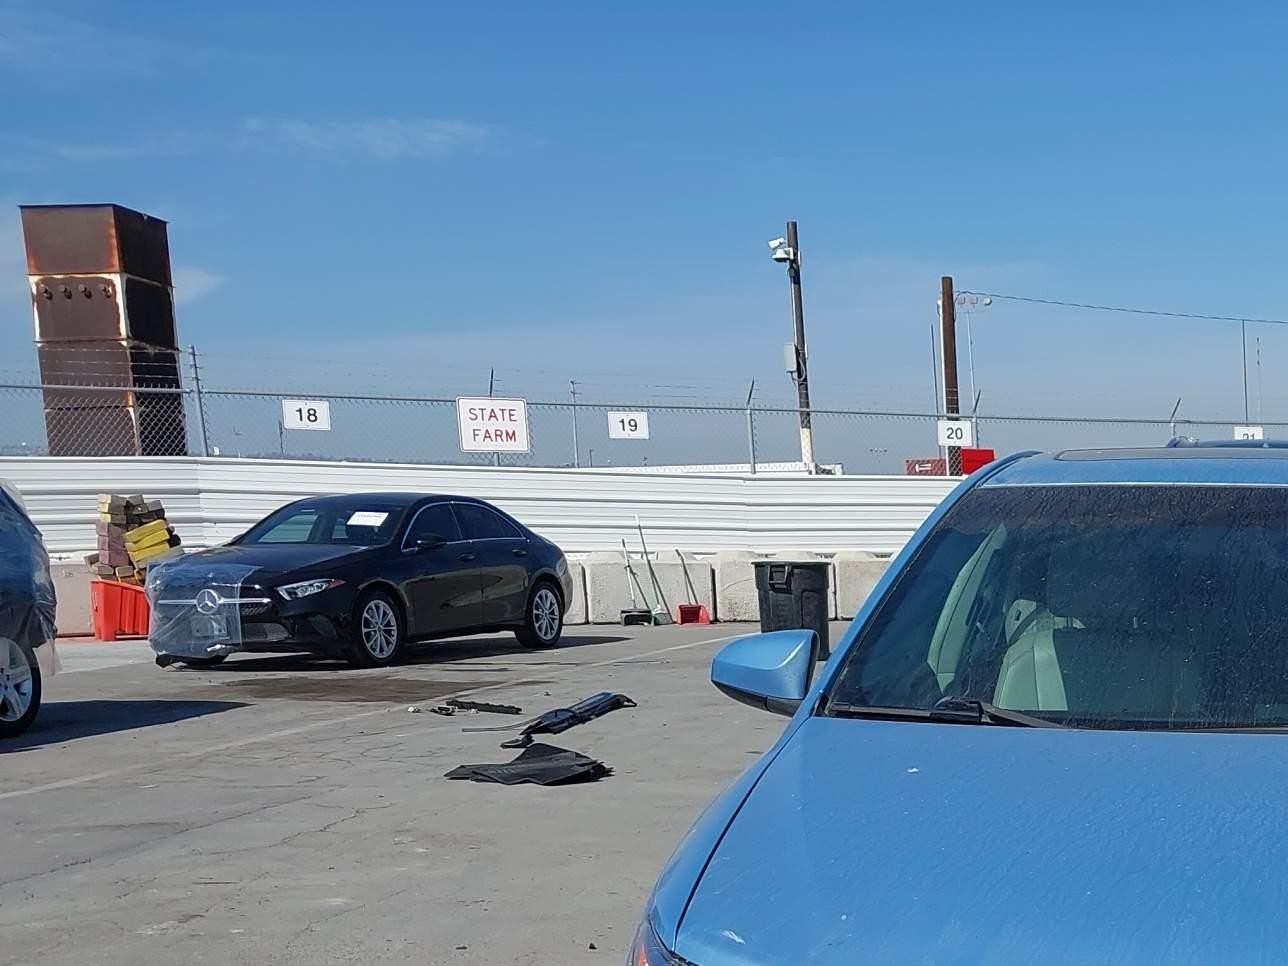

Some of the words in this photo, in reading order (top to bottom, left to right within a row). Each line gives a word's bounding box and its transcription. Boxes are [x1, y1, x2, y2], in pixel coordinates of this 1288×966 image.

[295, 407, 318, 423] 18
[468, 407, 518, 422] STATE
[618, 418, 638, 432] 19
[472, 428, 517, 443] FARM
[946, 426, 964, 440] 20
